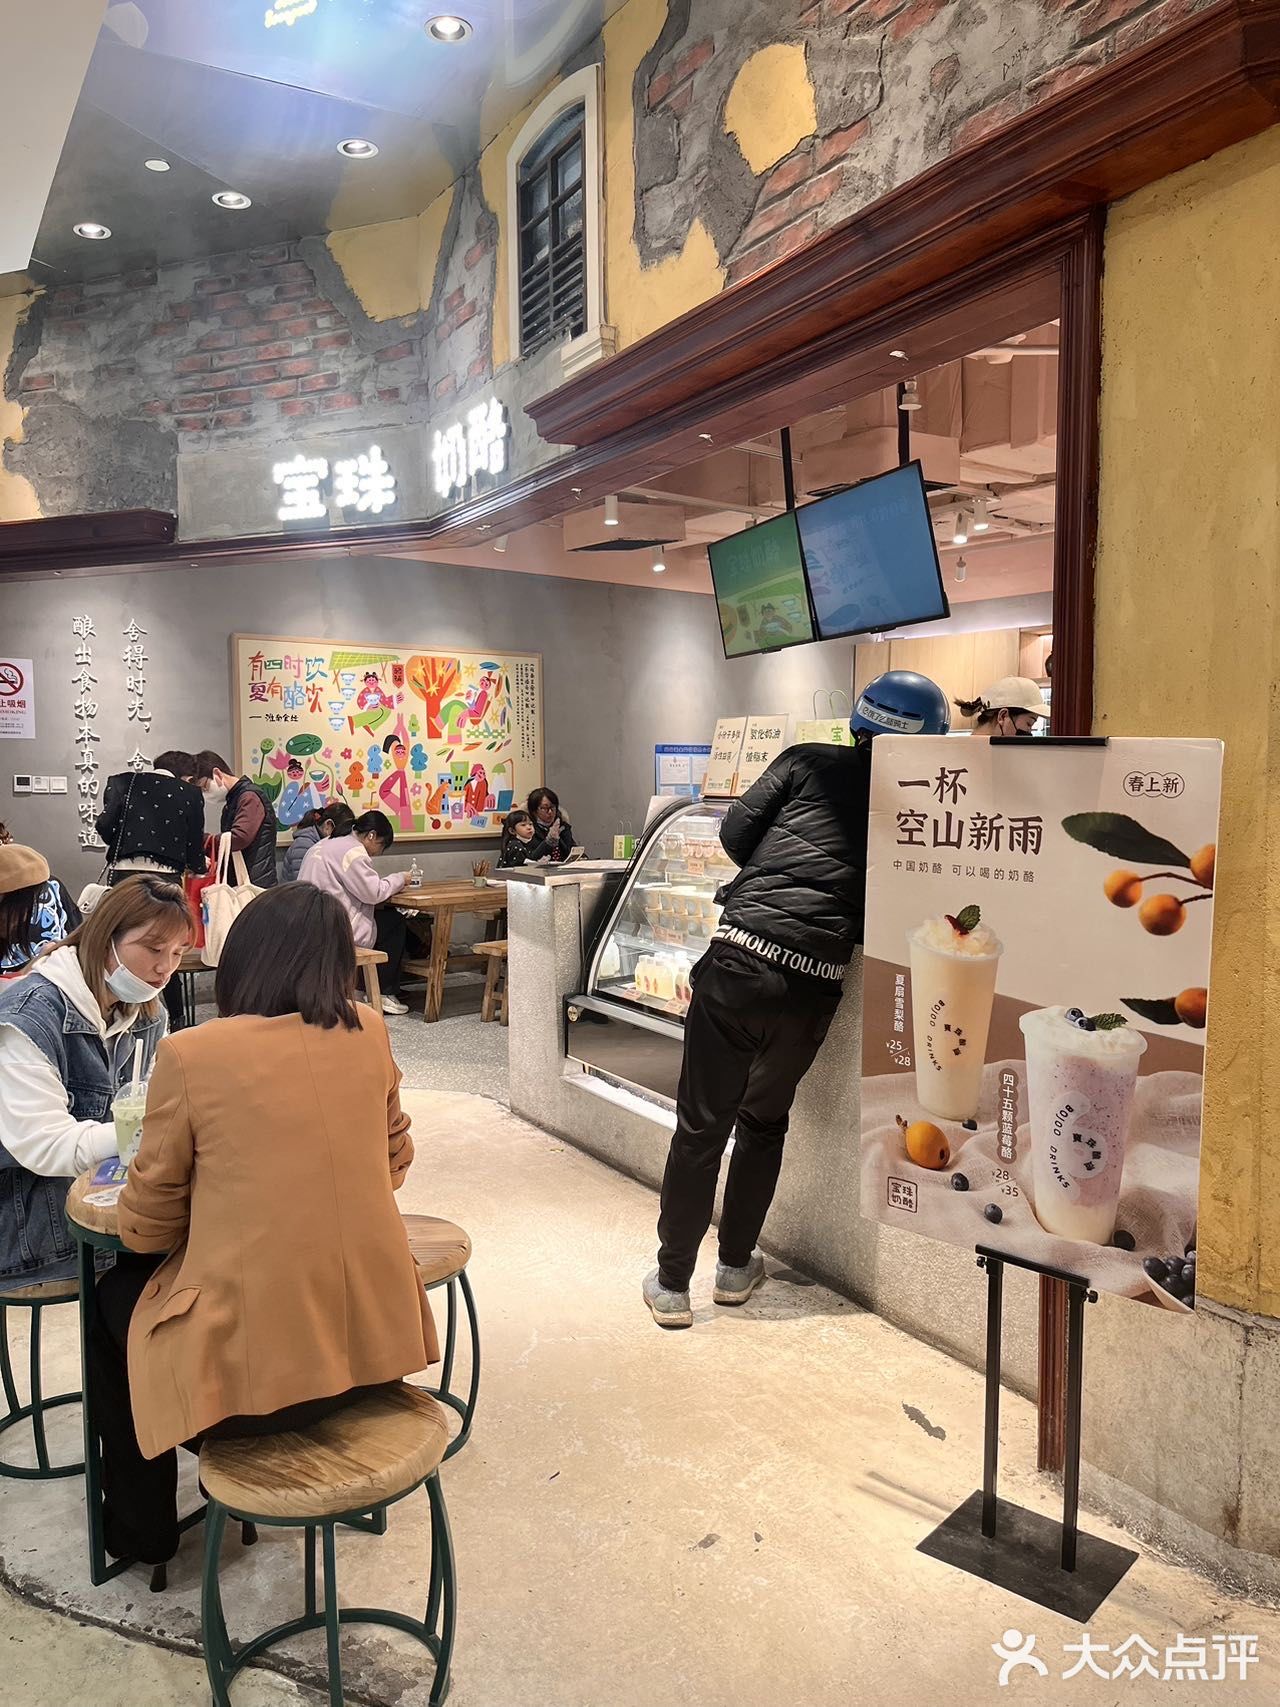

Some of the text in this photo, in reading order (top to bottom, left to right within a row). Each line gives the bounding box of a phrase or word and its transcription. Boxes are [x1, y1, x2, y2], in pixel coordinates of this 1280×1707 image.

[248, 651, 328, 681] 有四时饮
[248, 676, 325, 712] 夏有酪饮
[72, 614, 105, 850] 酿出食物本真的味道
[897, 767, 969, 805] 一杯
[1128, 775, 1180, 794] 春上新
[896, 808, 1044, 855] 空山新雨
[893, 859, 1036, 883] 中国奶酪 可以喝的奶酪
[930, 1000, 946, 1027] BOJOO
[926, 1035, 943, 1071] DRINKS
[1001, 1073, 1014, 1159] 四十五颗蓝莓酪
[1053, 1104, 1075, 1137] BOJOO
[1049, 1145, 1071, 1189] DRINKS
